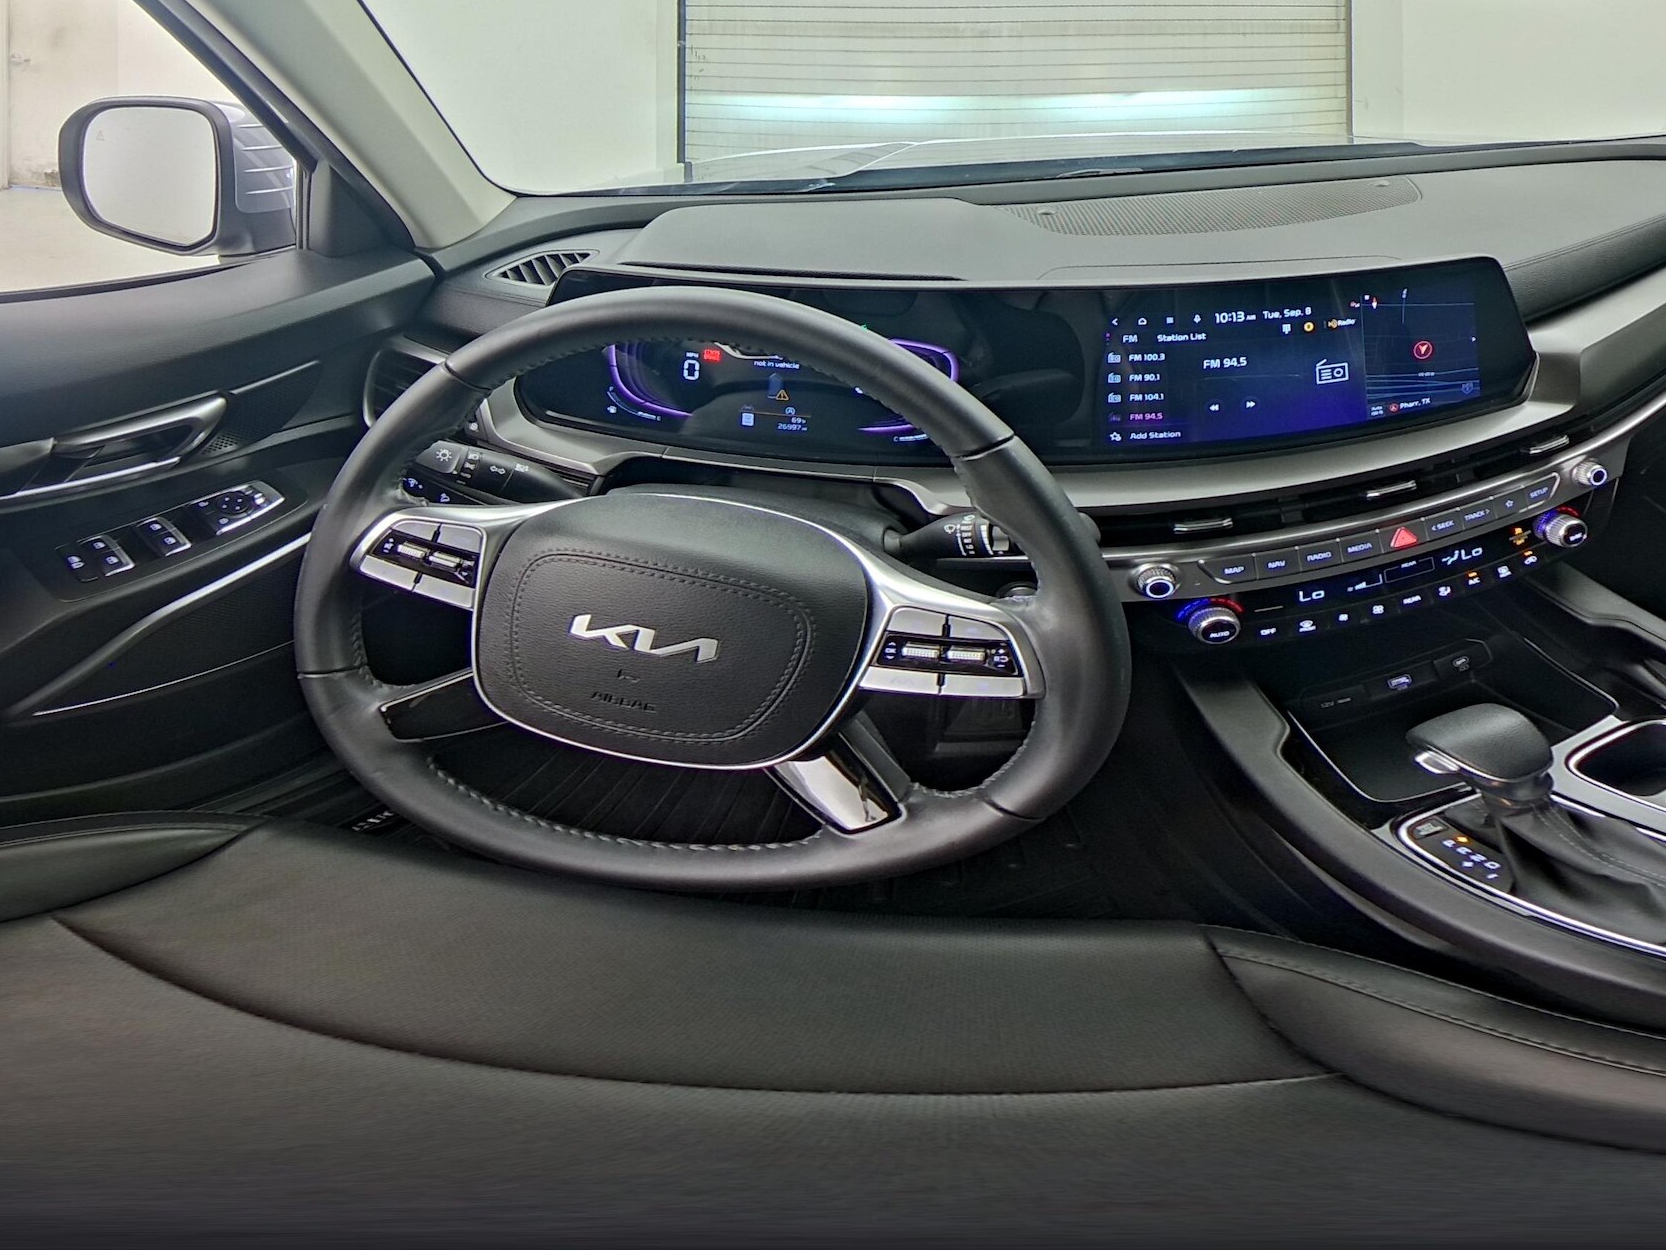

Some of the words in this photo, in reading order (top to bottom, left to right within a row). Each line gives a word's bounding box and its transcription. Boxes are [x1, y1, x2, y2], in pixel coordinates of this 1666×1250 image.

[1214, 311, 1246, 323] 10:13
[1263, 310, 1282, 320] Tue,
[1284, 308, 1303, 319] Sep.
[1305, 306, 1312, 315] 8
[1123, 335, 1137, 343] FM
[1157, 333, 1188, 342] Station
[1190, 332, 1206, 341] List
[1129, 353, 1142, 362] FM
[1144, 352, 1165, 362] 100.3
[775, 361, 800, 369] vehicle
[1203, 358, 1221, 369] FM
[1223, 356, 1247, 368] 94.5
[683, 359, 700, 380] 0
[1129, 374, 1142, 382] FM
[1144, 373, 1160, 382] 90.1
[1130, 393, 1143, 402] FM
[1145, 392, 1164, 401] 104.1
[1421, 398, 1431, 406] TX
[1130, 413, 1143, 421] FM
[1145, 412, 1163, 421] 94.5
[777, 423, 802, 431] 26997
[1130, 432, 1148, 440] Add
[1150, 430, 1181, 440] Station
[1529, 487, 1549, 499] SETUP
[1464, 510, 1485, 522] TRACK
[1438, 520, 1455, 530] SEEK
[1347, 543, 1373, 554] MEDIA
[1307, 552, 1332, 562] RADIO
[1461, 547, 1483, 561] Lo
[1268, 560, 1286, 570] NAV
[1225, 566, 1245, 576] MAP
[1299, 590, 1326, 603] Lo
[1209, 630, 1231, 639] AUTO
[1260, 628, 1277, 636] OFF
